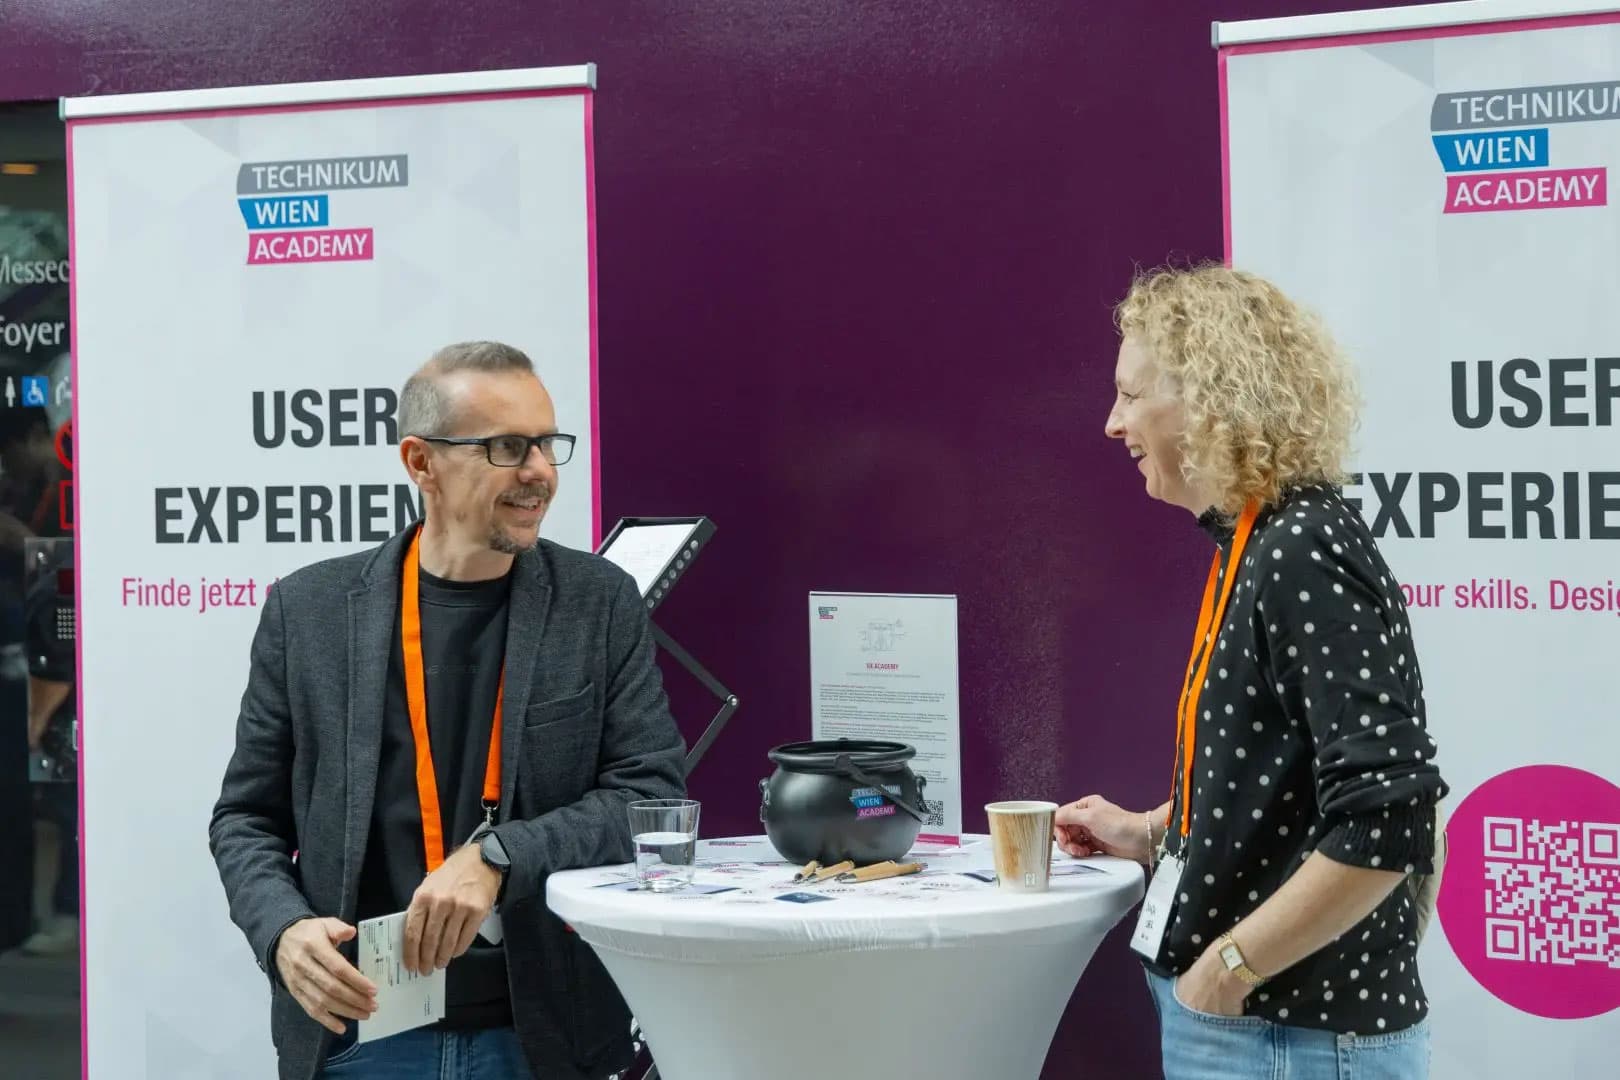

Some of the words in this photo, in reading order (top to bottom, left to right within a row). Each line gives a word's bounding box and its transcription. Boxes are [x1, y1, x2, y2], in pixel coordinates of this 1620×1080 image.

[1450, 86, 1620, 124] TECHNIKU
[1454, 135, 1536, 166] WIEN
[252, 160, 400, 189] TECHNIKUM
[1453, 174, 1599, 208] ACADEMY
[254, 200, 320, 225] WIEN
[254, 233, 368, 260] ACADEMY
[252, 388, 399, 449] USER
[155, 485, 424, 543] EXPERIEN
[122, 577, 191, 606] Finde
[199, 577, 257, 613] jetzt
[1454, 578, 1537, 610] skills.
[859, 798, 880, 806] WIEN
[859, 807, 894, 816] ACADEMY
